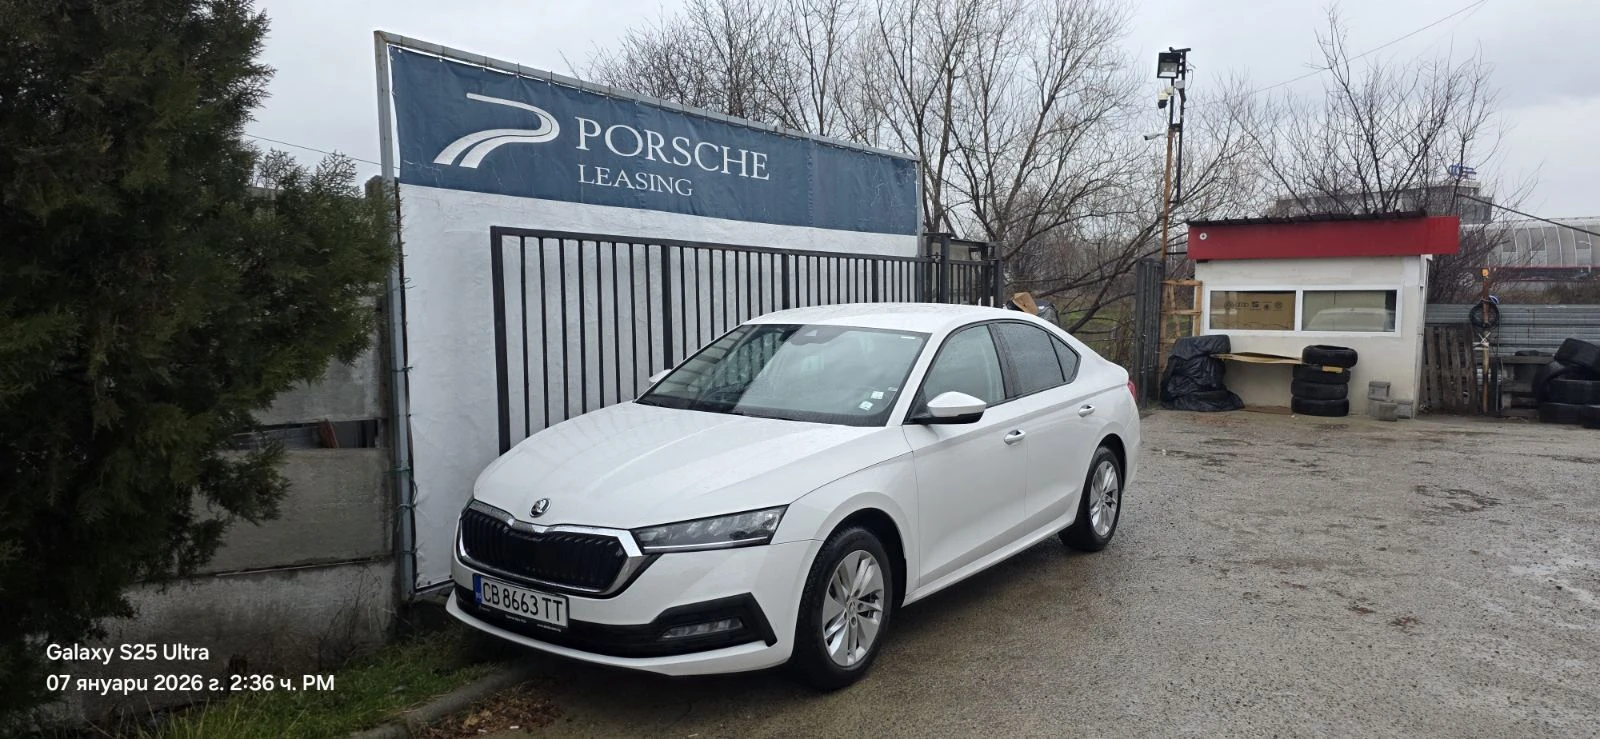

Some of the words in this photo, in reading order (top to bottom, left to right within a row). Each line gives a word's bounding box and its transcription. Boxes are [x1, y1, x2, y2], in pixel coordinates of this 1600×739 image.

[575, 116, 770, 181] PORSCHE
[578, 164, 693, 197] LEASING
[482, 581, 501, 606] CB
[502, 587, 539, 616] 8663
[541, 596, 563, 622] TT
